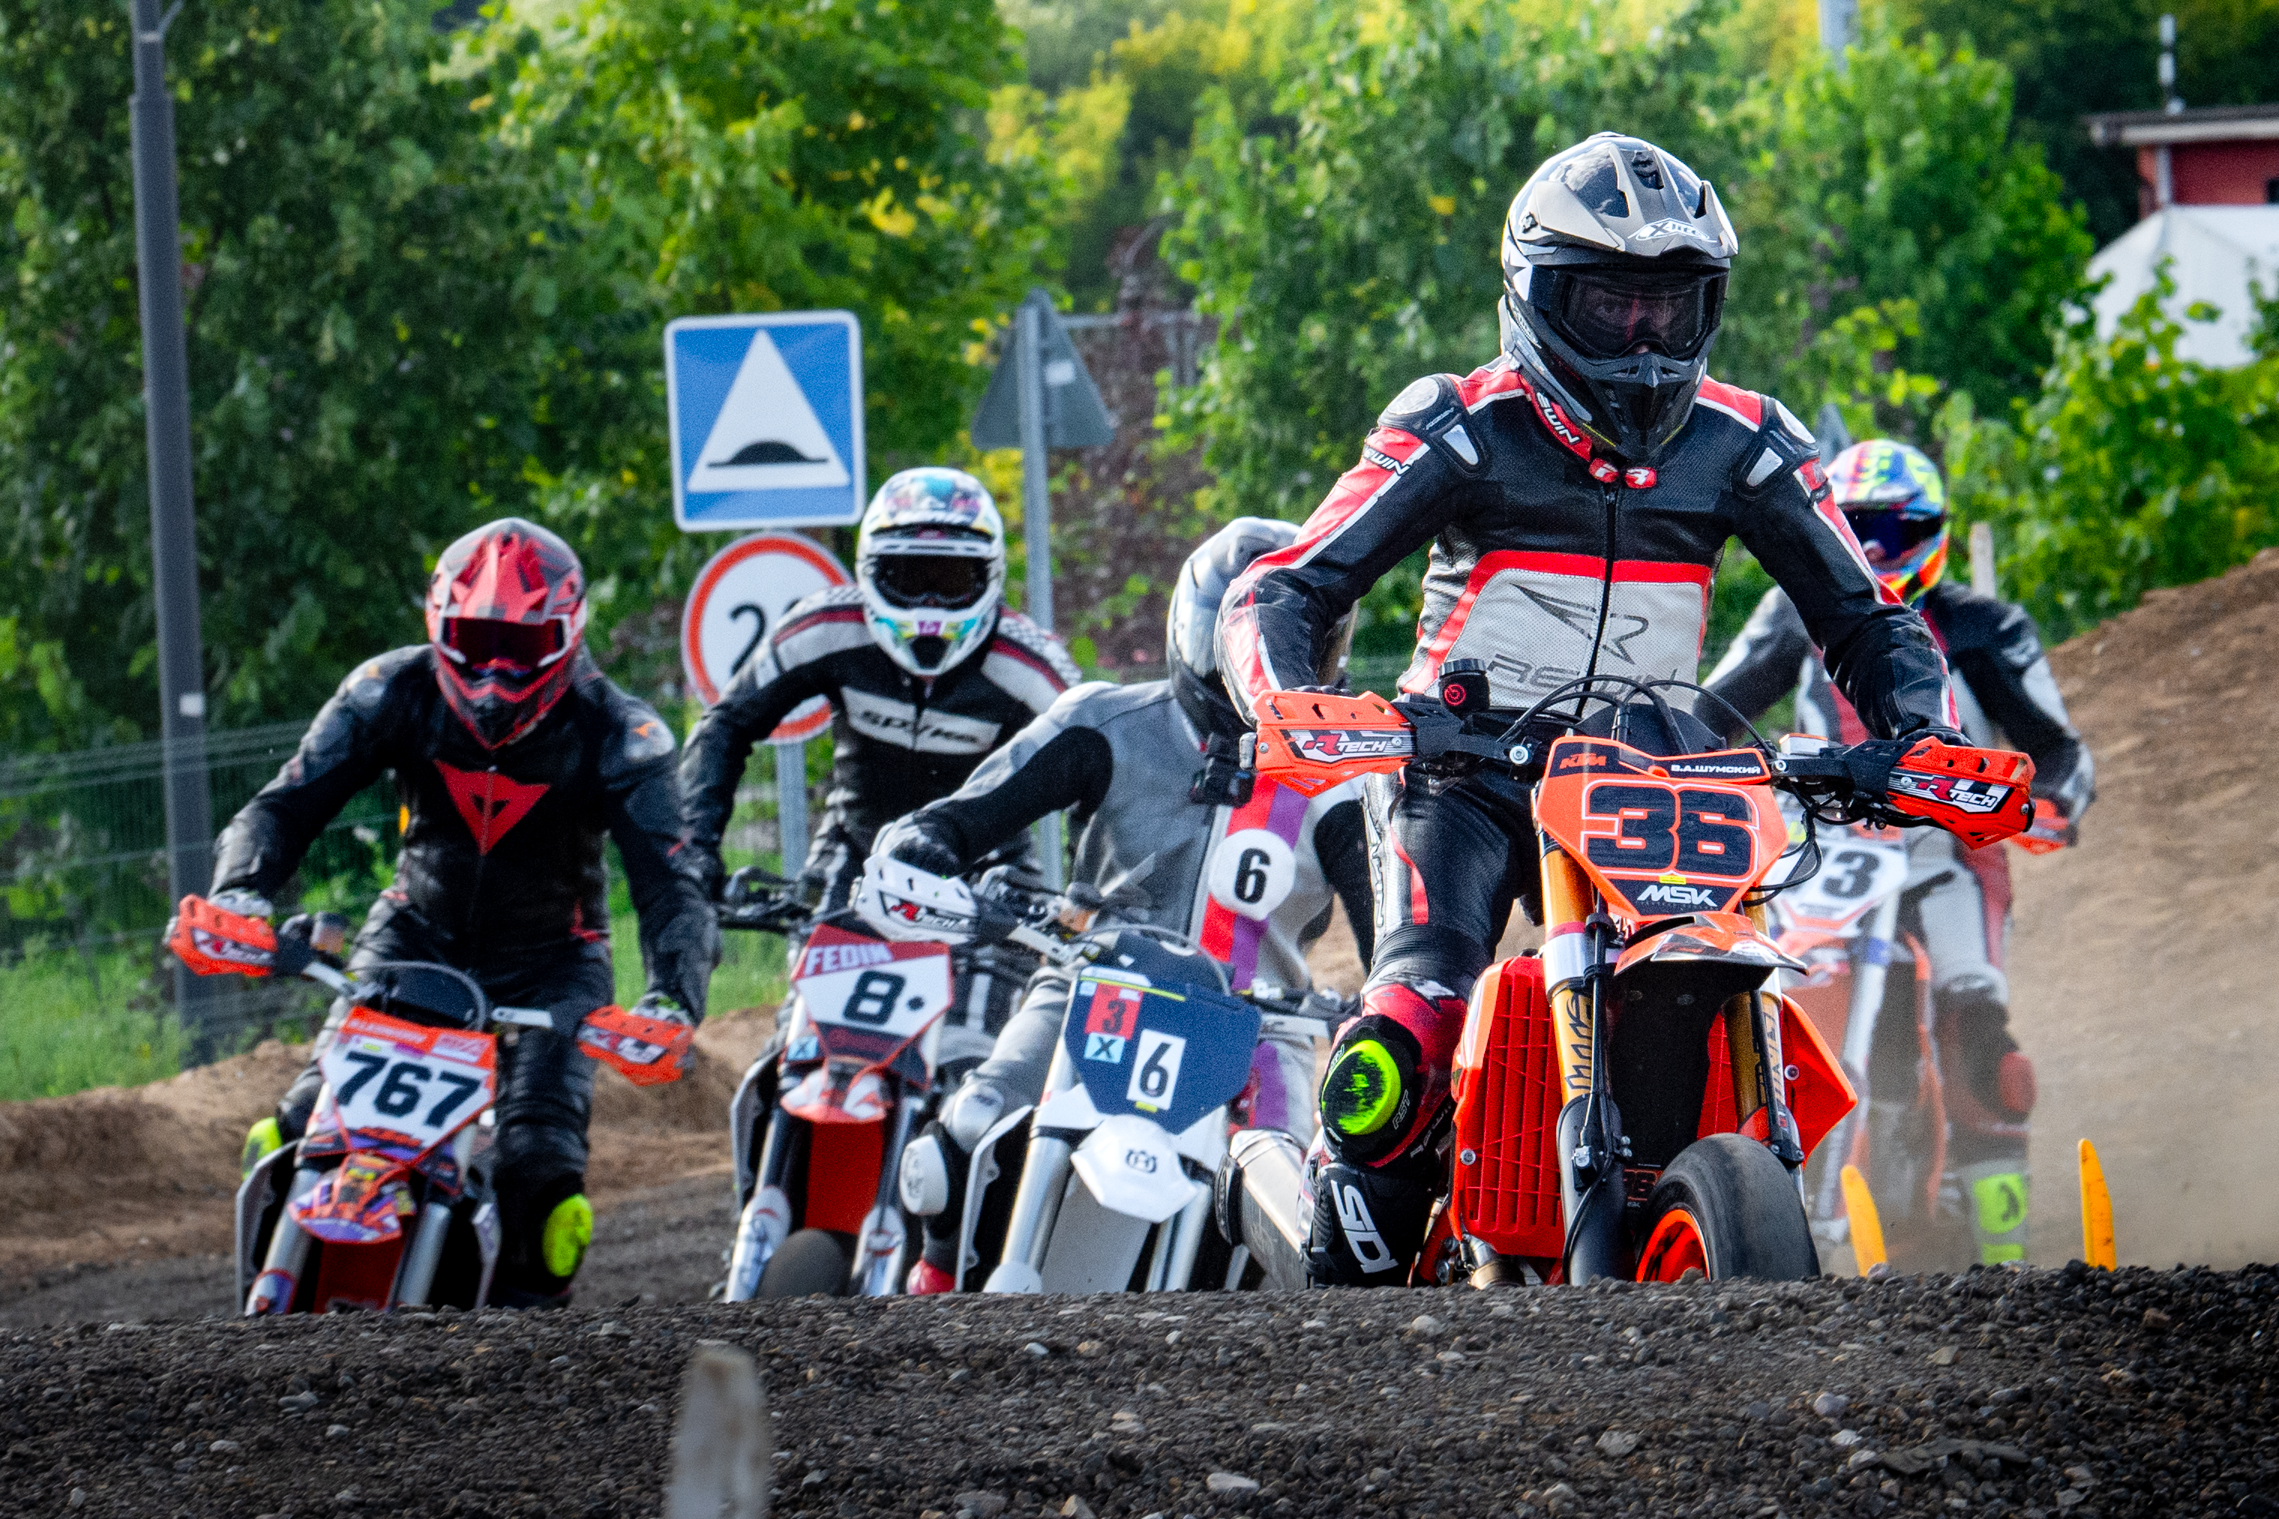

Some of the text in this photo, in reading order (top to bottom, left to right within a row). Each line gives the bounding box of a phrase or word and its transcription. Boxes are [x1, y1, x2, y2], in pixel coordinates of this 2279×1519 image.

[1536, 392, 1580, 445] EWIN
[1559, 753, 1607, 770] KTM
[1670, 763, 1761, 775] В.А.ШУМСКИЙ
[1582, 782, 1757, 880] 36
[1234, 847, 1271, 905] 6
[1636, 884, 1719, 908] MSK
[843, 970, 906, 1026] 8
[1101, 1000, 1127, 1035] 3
[1092, 1035, 1120, 1059] X
[1139, 1041, 1173, 1099] 6
[336, 1050, 483, 1130] 767
